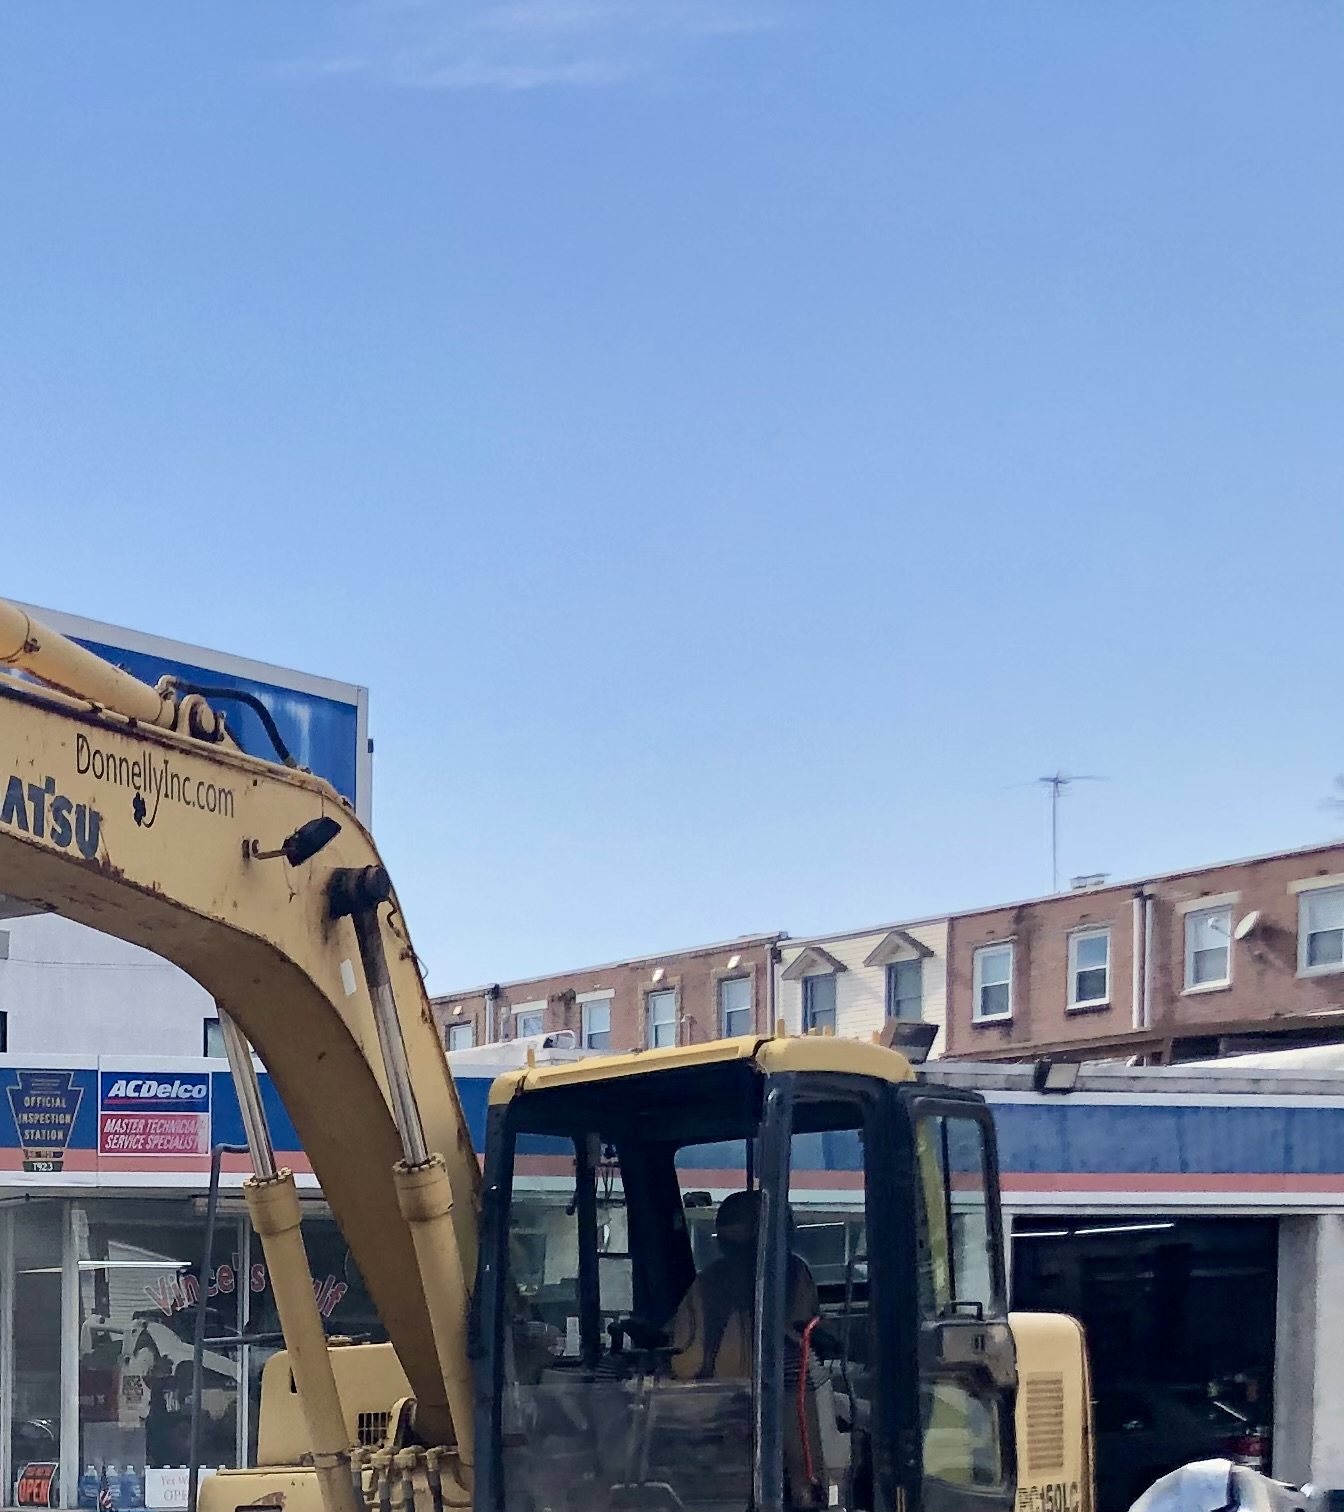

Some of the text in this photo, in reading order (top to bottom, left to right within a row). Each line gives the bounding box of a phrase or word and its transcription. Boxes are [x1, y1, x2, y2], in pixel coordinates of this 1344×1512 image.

[76, 733, 235, 828] DonnellyInc.com
[107, 1079, 208, 1099] ACDelco
[23, 1096, 67, 1108] OFFICIAL
[18, 1112, 72, 1124] INSPECTION
[104, 1118, 145, 1133] MASTER
[24, 1129, 65, 1140] STATION
[105, 1134, 200, 1150] SERVICE SPECIALIST
[19, 1478, 50, 1504] OPEN
